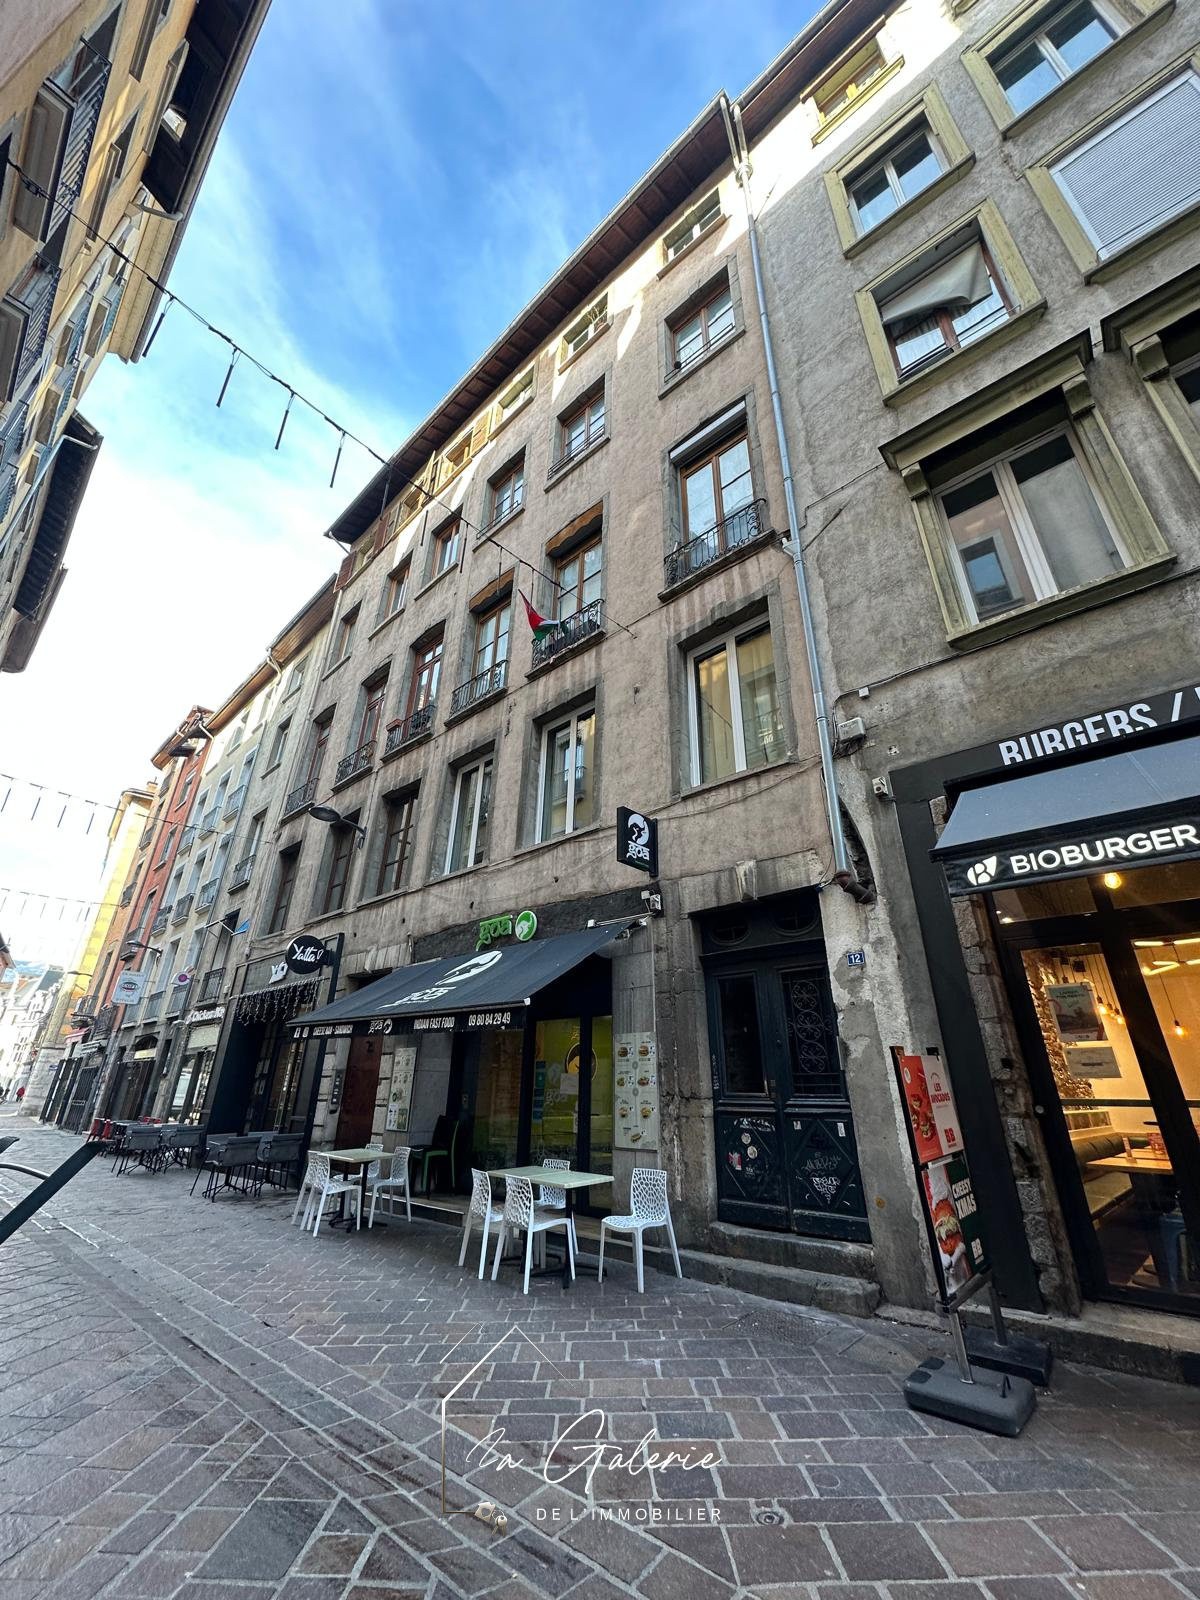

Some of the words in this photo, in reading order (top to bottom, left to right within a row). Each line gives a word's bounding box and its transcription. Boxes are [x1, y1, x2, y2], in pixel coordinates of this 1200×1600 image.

[999, 703, 1158, 765] BURGERS
[1010, 824, 1200, 874] BIOBURGER
[429, 1018, 441, 1029] FAST
[441, 1017, 455, 1028] FOOD
[468, 1015, 477, 1026] 09
[476, 1014, 485, 1025] 80
[485, 1014, 493, 1025] 84
[493, 1013, 502, 1025] 29
[502, 1012, 511, 1024] 49
[952, 1178, 972, 1199] CHEESY
[955, 1193, 977, 1219] XMAS
